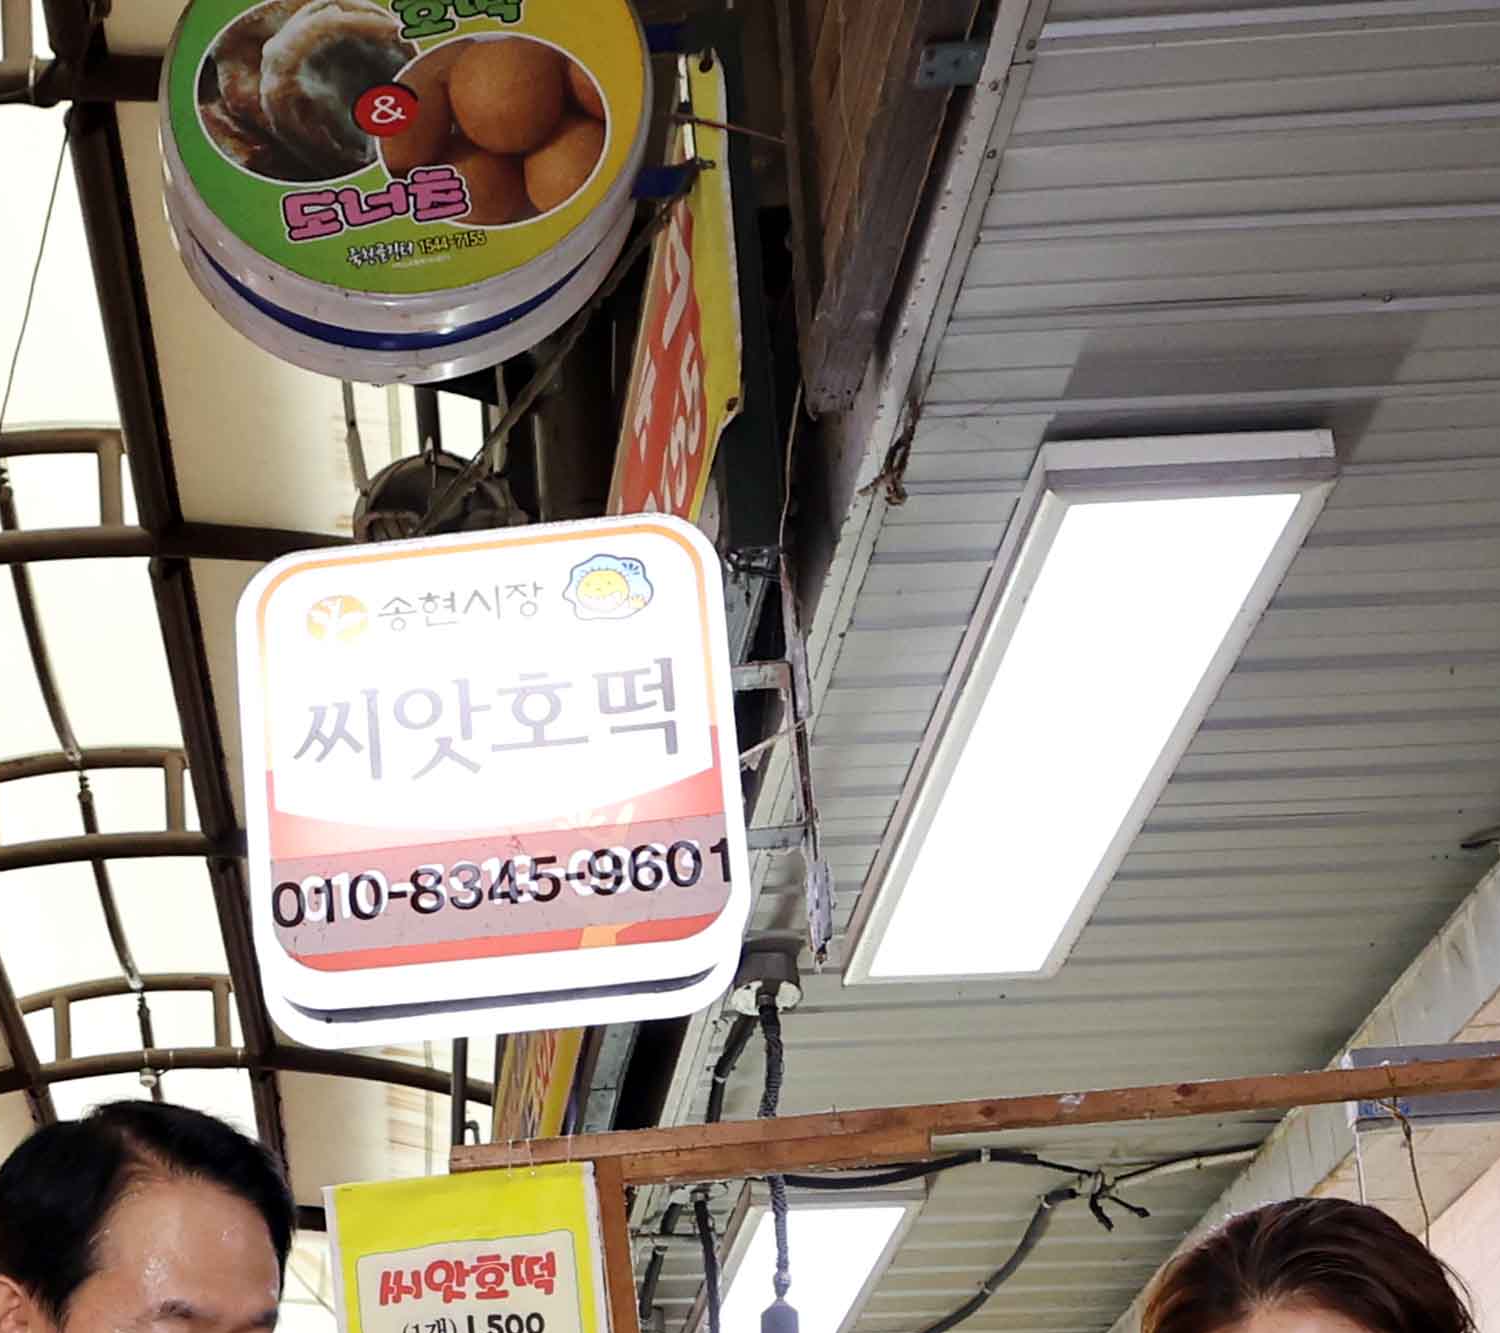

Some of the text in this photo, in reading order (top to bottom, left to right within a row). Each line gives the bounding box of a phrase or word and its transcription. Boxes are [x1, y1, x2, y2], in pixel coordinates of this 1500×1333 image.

[377, 580, 545, 632] 송현시장
[293, 656, 679, 781] 씨앗호떡
[271, 837, 733, 928] 010-8345-9601
[379, 1250, 558, 1306] 씨앗호떡
